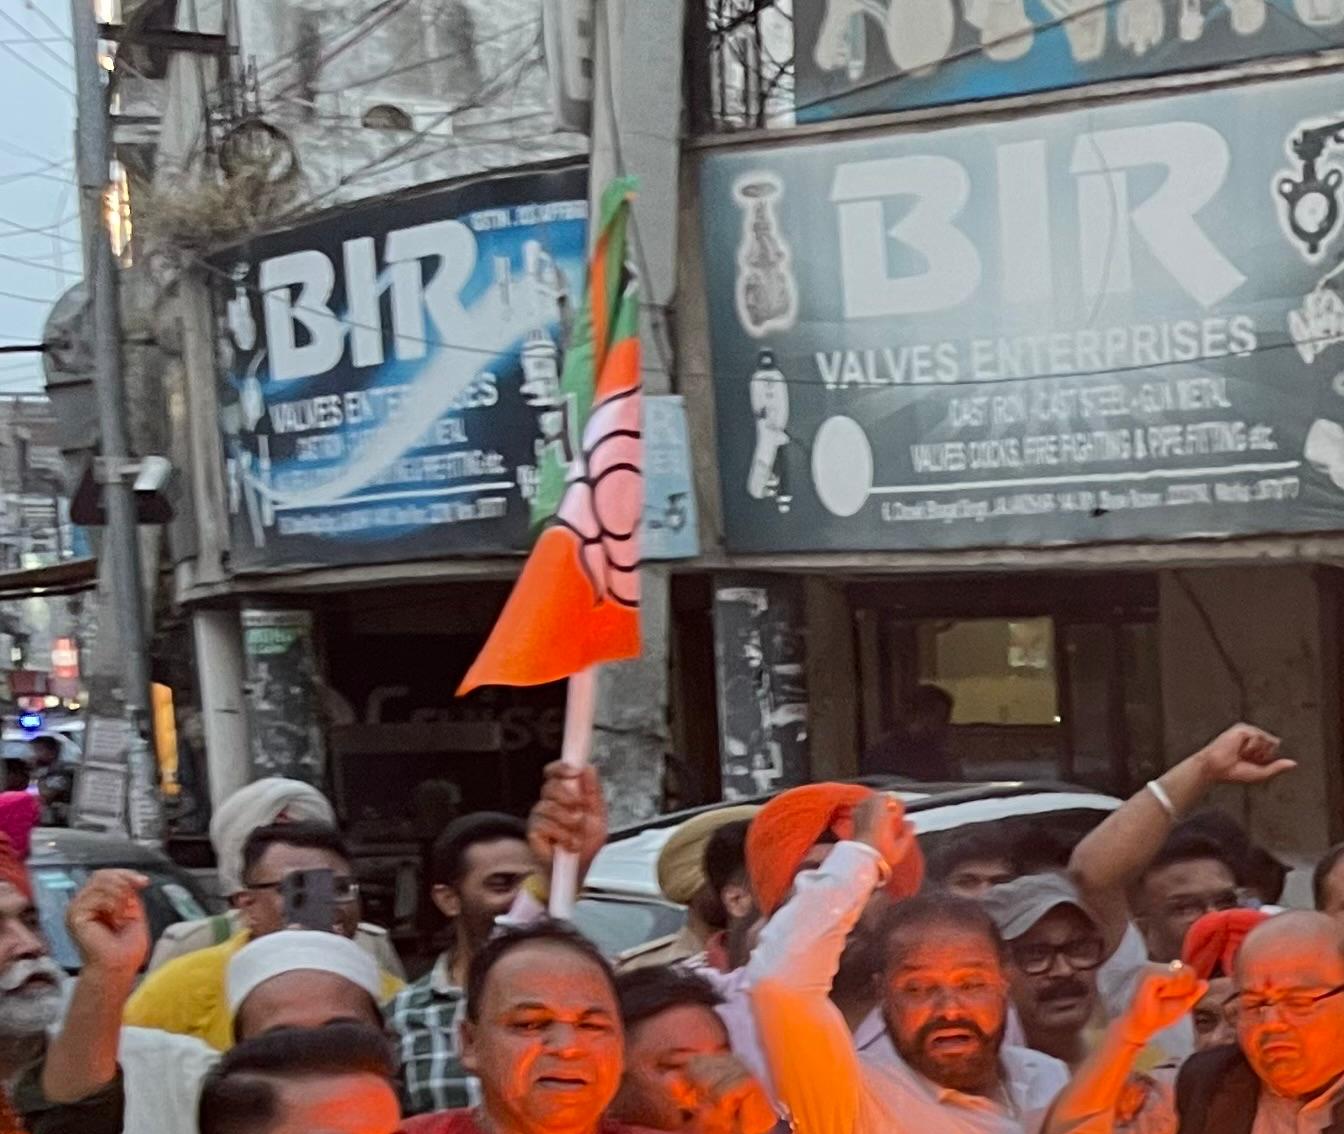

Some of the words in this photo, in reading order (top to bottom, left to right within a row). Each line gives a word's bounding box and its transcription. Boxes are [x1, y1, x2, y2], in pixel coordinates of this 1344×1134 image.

[258, 219, 482, 382] BIR
[830, 120, 1248, 319] BIR
[816, 342, 959, 389] VALVES
[972, 315, 1257, 380] ENTERPRISES
